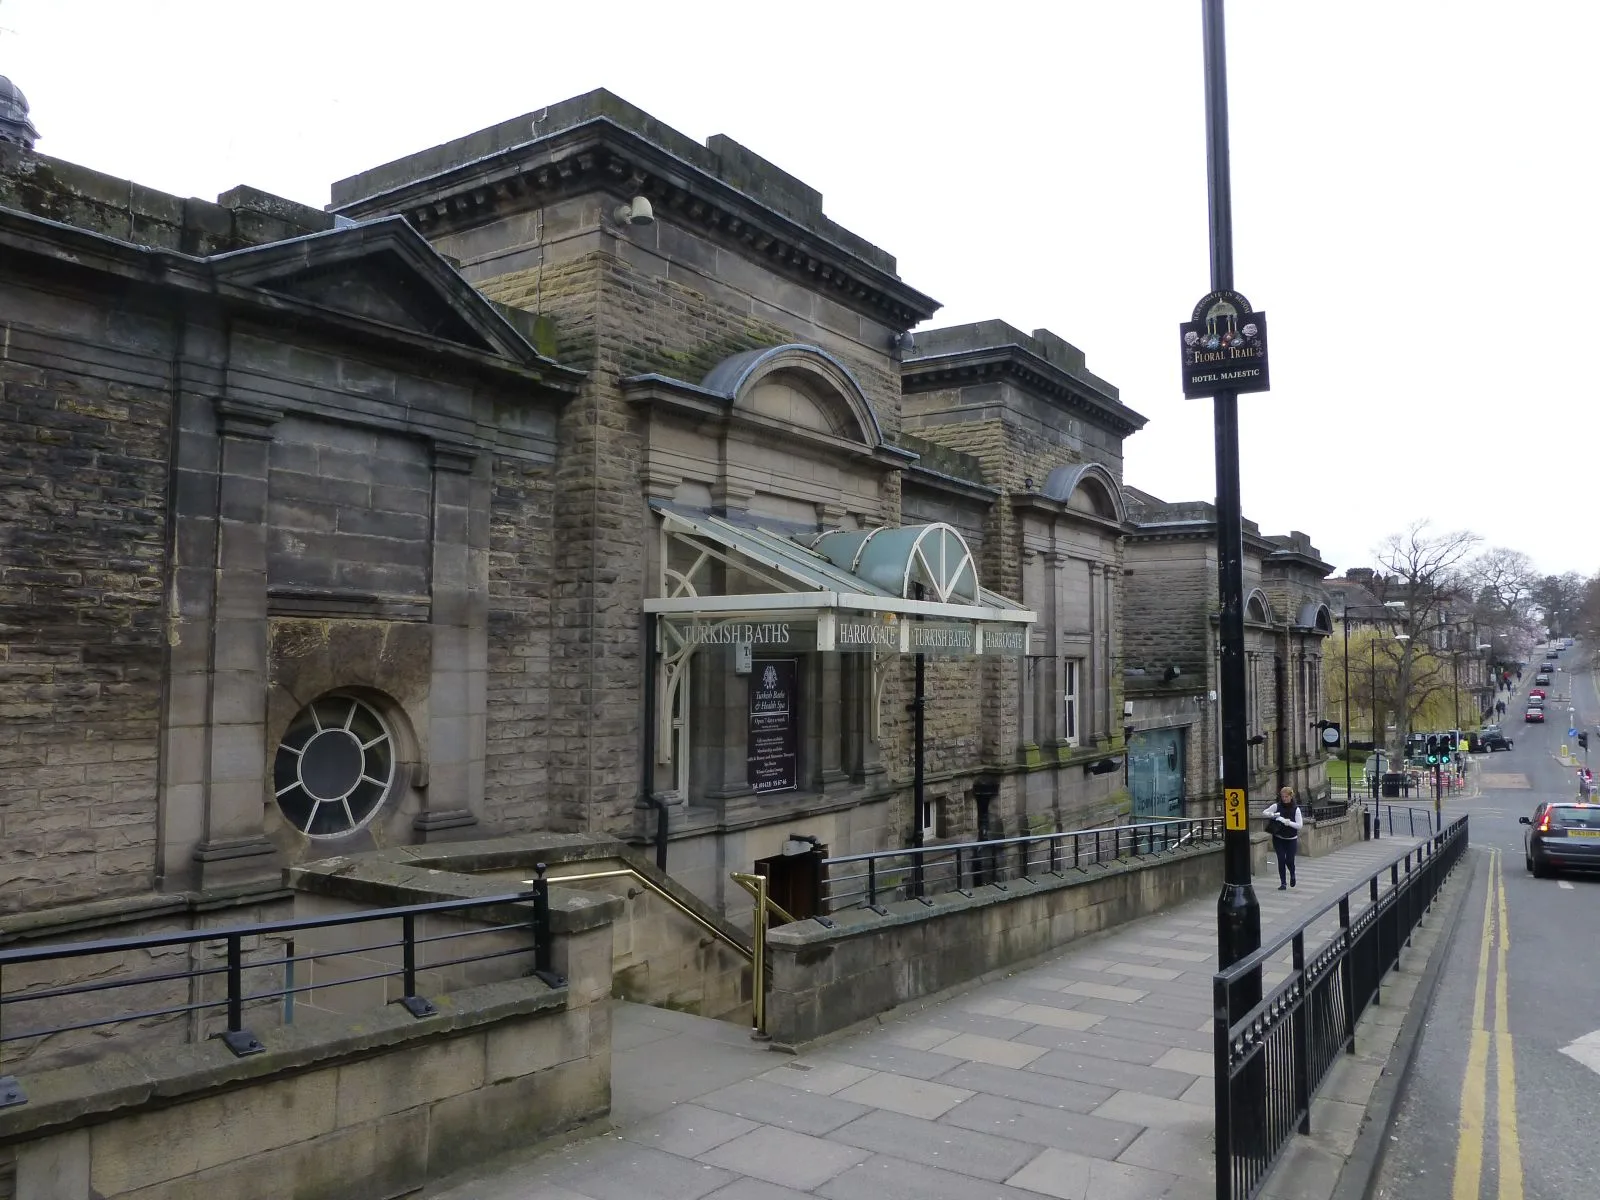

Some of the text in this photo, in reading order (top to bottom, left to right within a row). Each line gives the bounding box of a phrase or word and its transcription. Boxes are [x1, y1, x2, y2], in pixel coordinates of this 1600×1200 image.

[1193, 291, 1223, 321] HARROGATE
[1235, 295, 1250, 314] BLOOM
[1194, 346, 1255, 364] FLORAL TRAIL
[1192, 368, 1260, 383] HOTEL MAJESTIC
[684, 623, 790, 644] TURKISH BATHS
[840, 623, 895, 645] HARROGATE
[914, 627, 971, 648] TURKISH BATHS
[986, 631, 1022, 649] HARROGATE
